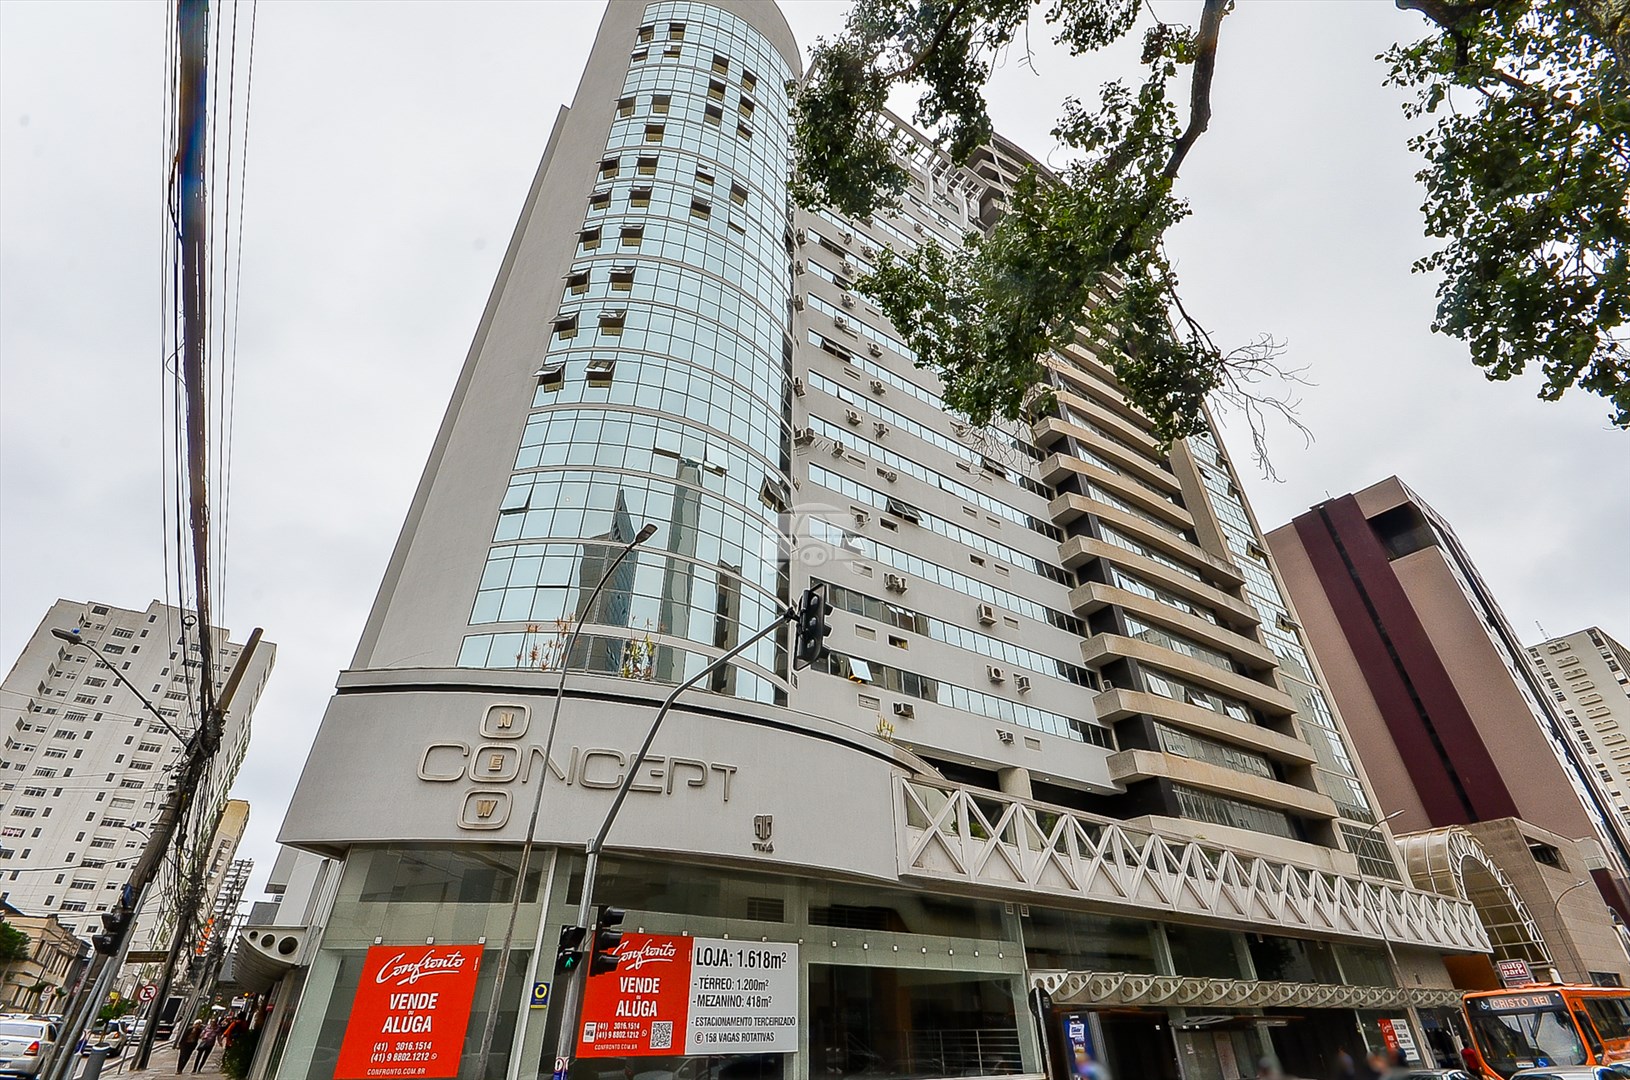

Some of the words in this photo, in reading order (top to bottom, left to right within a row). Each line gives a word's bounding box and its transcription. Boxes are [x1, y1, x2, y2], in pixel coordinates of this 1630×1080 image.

[417, 742, 738, 801] CONCEPT
[696, 947, 733, 967] LOJA:
[375, 949, 466, 986] Confronto
[1501, 962, 1522, 970] auto
[1503, 968, 1525, 977] park
[620, 976, 660, 994] VENDE
[389, 992, 439, 1010] VENDE
[697, 994, 745, 1008] MEZANINO:
[1492, 998, 1529, 1009] CRISTO
[1531, 996, 1549, 1006] REI
[615, 1000, 658, 1017] ALUGA
[381, 1015, 432, 1033] ALUGA
[695, 1016, 752, 1027] ESTACIONAMENTO
[754, 1016, 796, 1026] TERCEIRIZADO
[705, 1033, 717, 1043] 158
[718, 1032, 740, 1043] VAGAS
[741, 1032, 775, 1042] ROTATIVAS
[373, 1042, 388, 1052] (41)
[395, 1041, 432, 1051] 3016.1514
[370, 1053, 386, 1063] (41)
[366, 1067, 426, 1076] CONFRONTO.COM.BR
